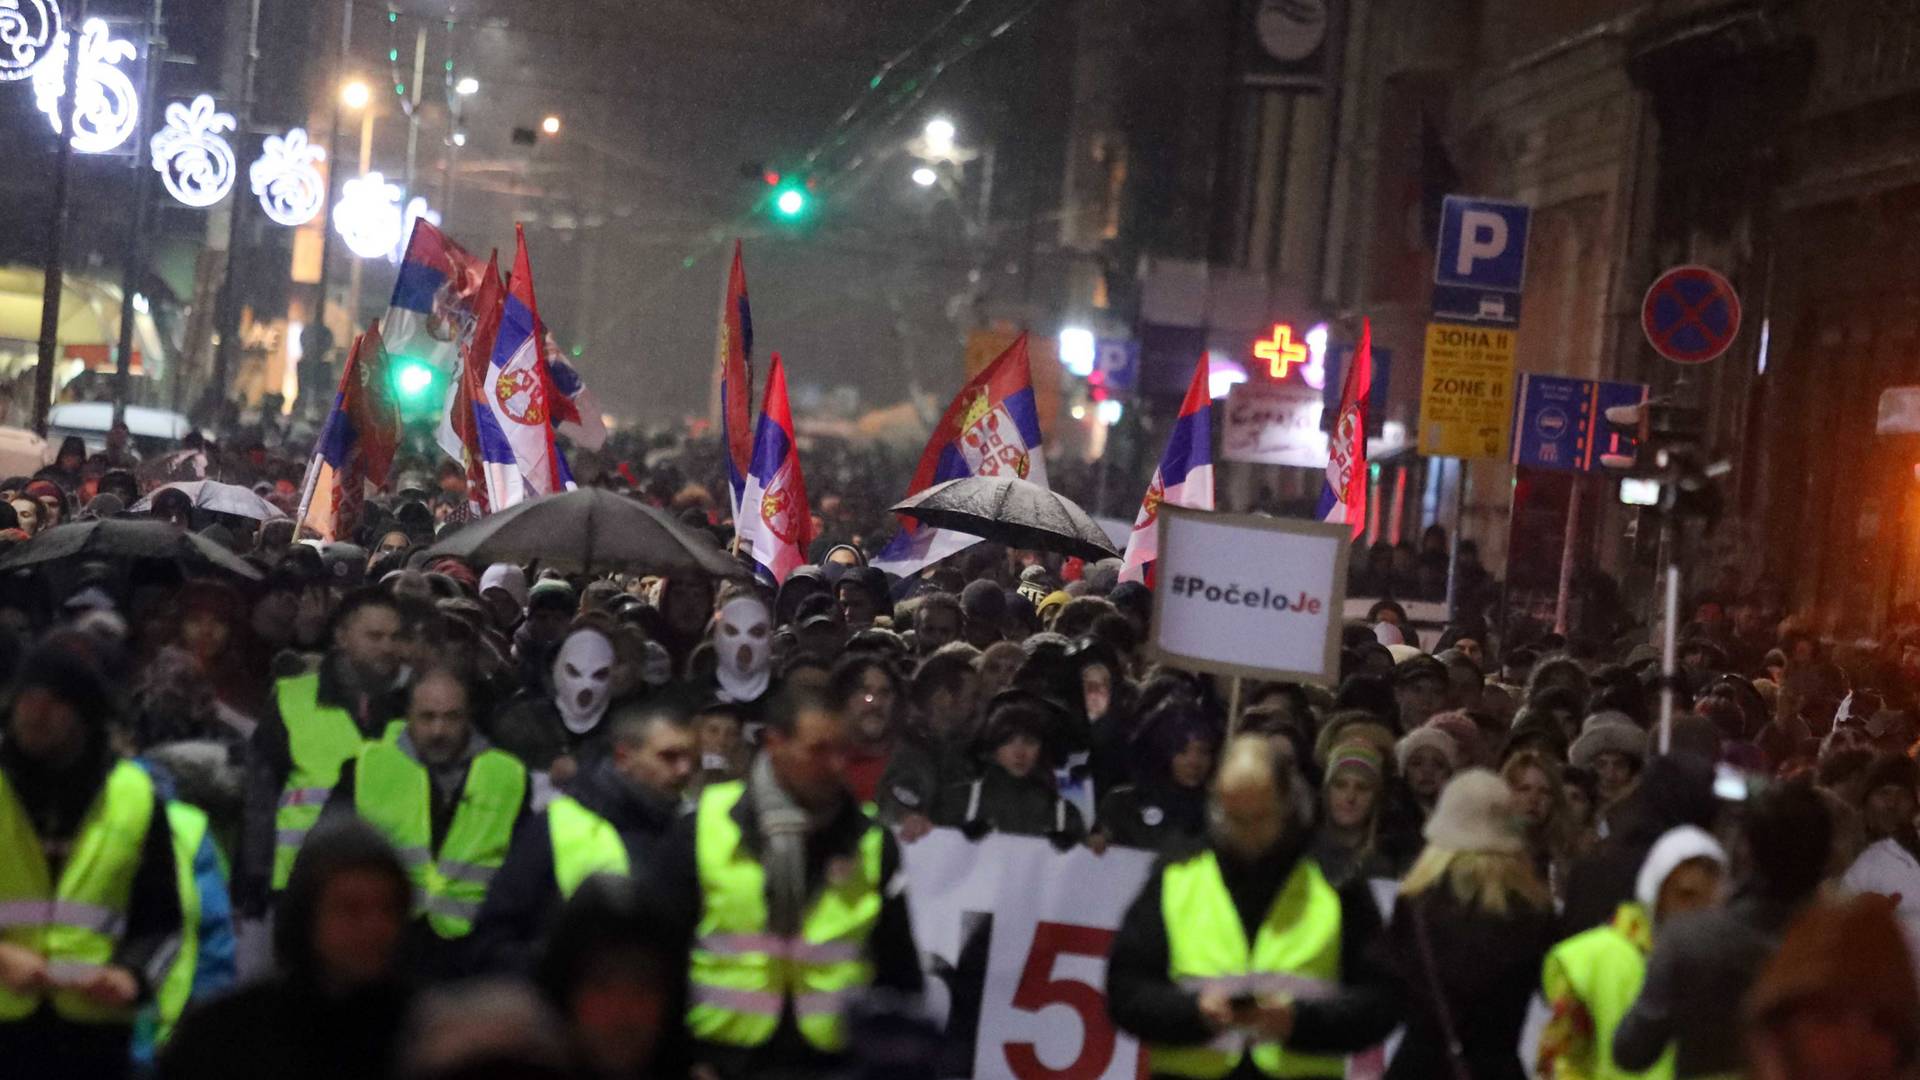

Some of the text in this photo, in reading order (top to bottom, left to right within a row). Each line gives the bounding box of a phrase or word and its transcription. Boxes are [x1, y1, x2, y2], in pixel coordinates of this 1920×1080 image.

[1457, 210, 1508, 275] P
[1435, 328, 1507, 349] ЗОНА II
[1431, 378, 1503, 397] ZONE II
[1172, 575, 1322, 615] #PočeloJe
